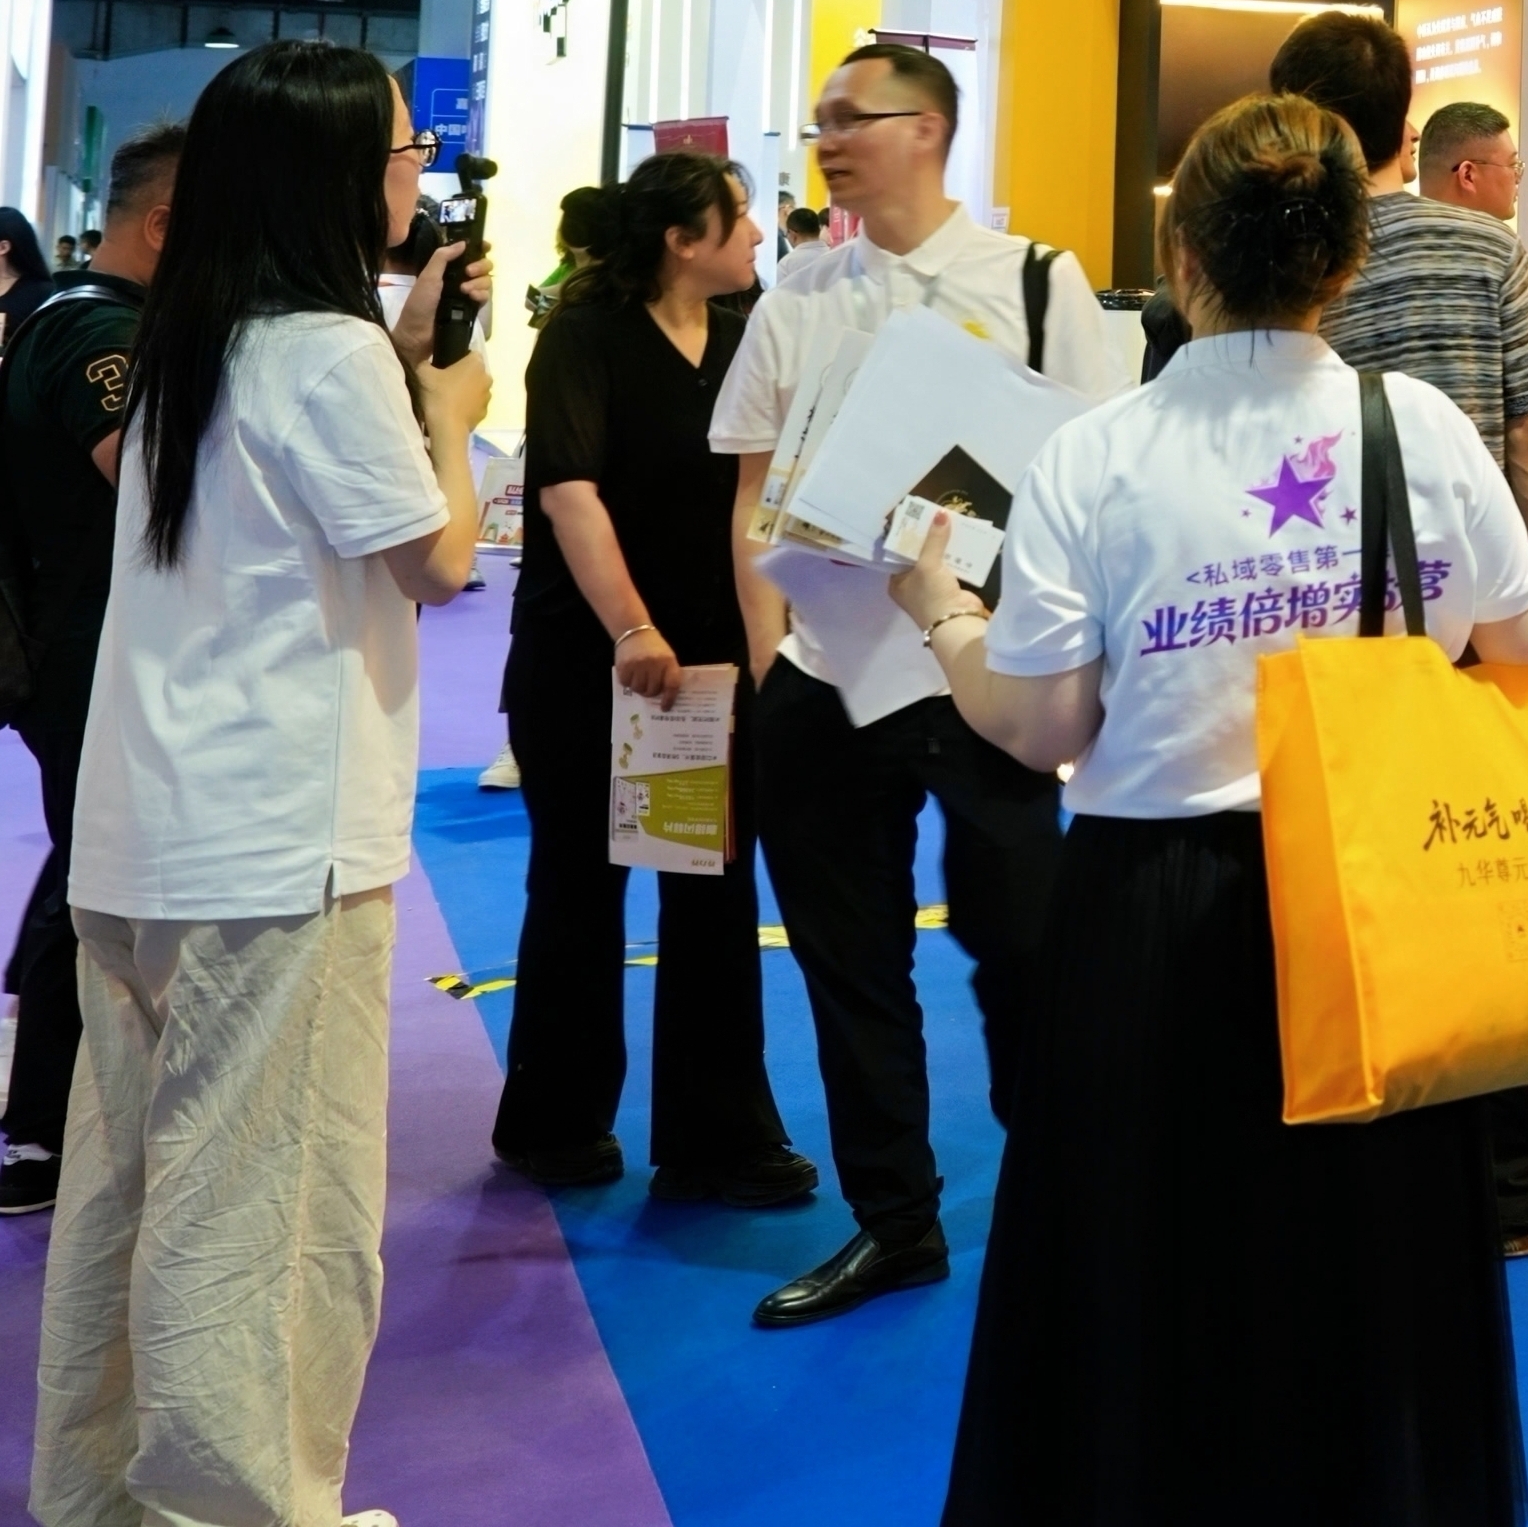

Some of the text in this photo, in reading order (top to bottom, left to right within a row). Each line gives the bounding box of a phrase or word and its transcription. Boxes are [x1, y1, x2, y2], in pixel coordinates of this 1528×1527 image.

[1186, 543, 1392, 589] <私域零售第一
